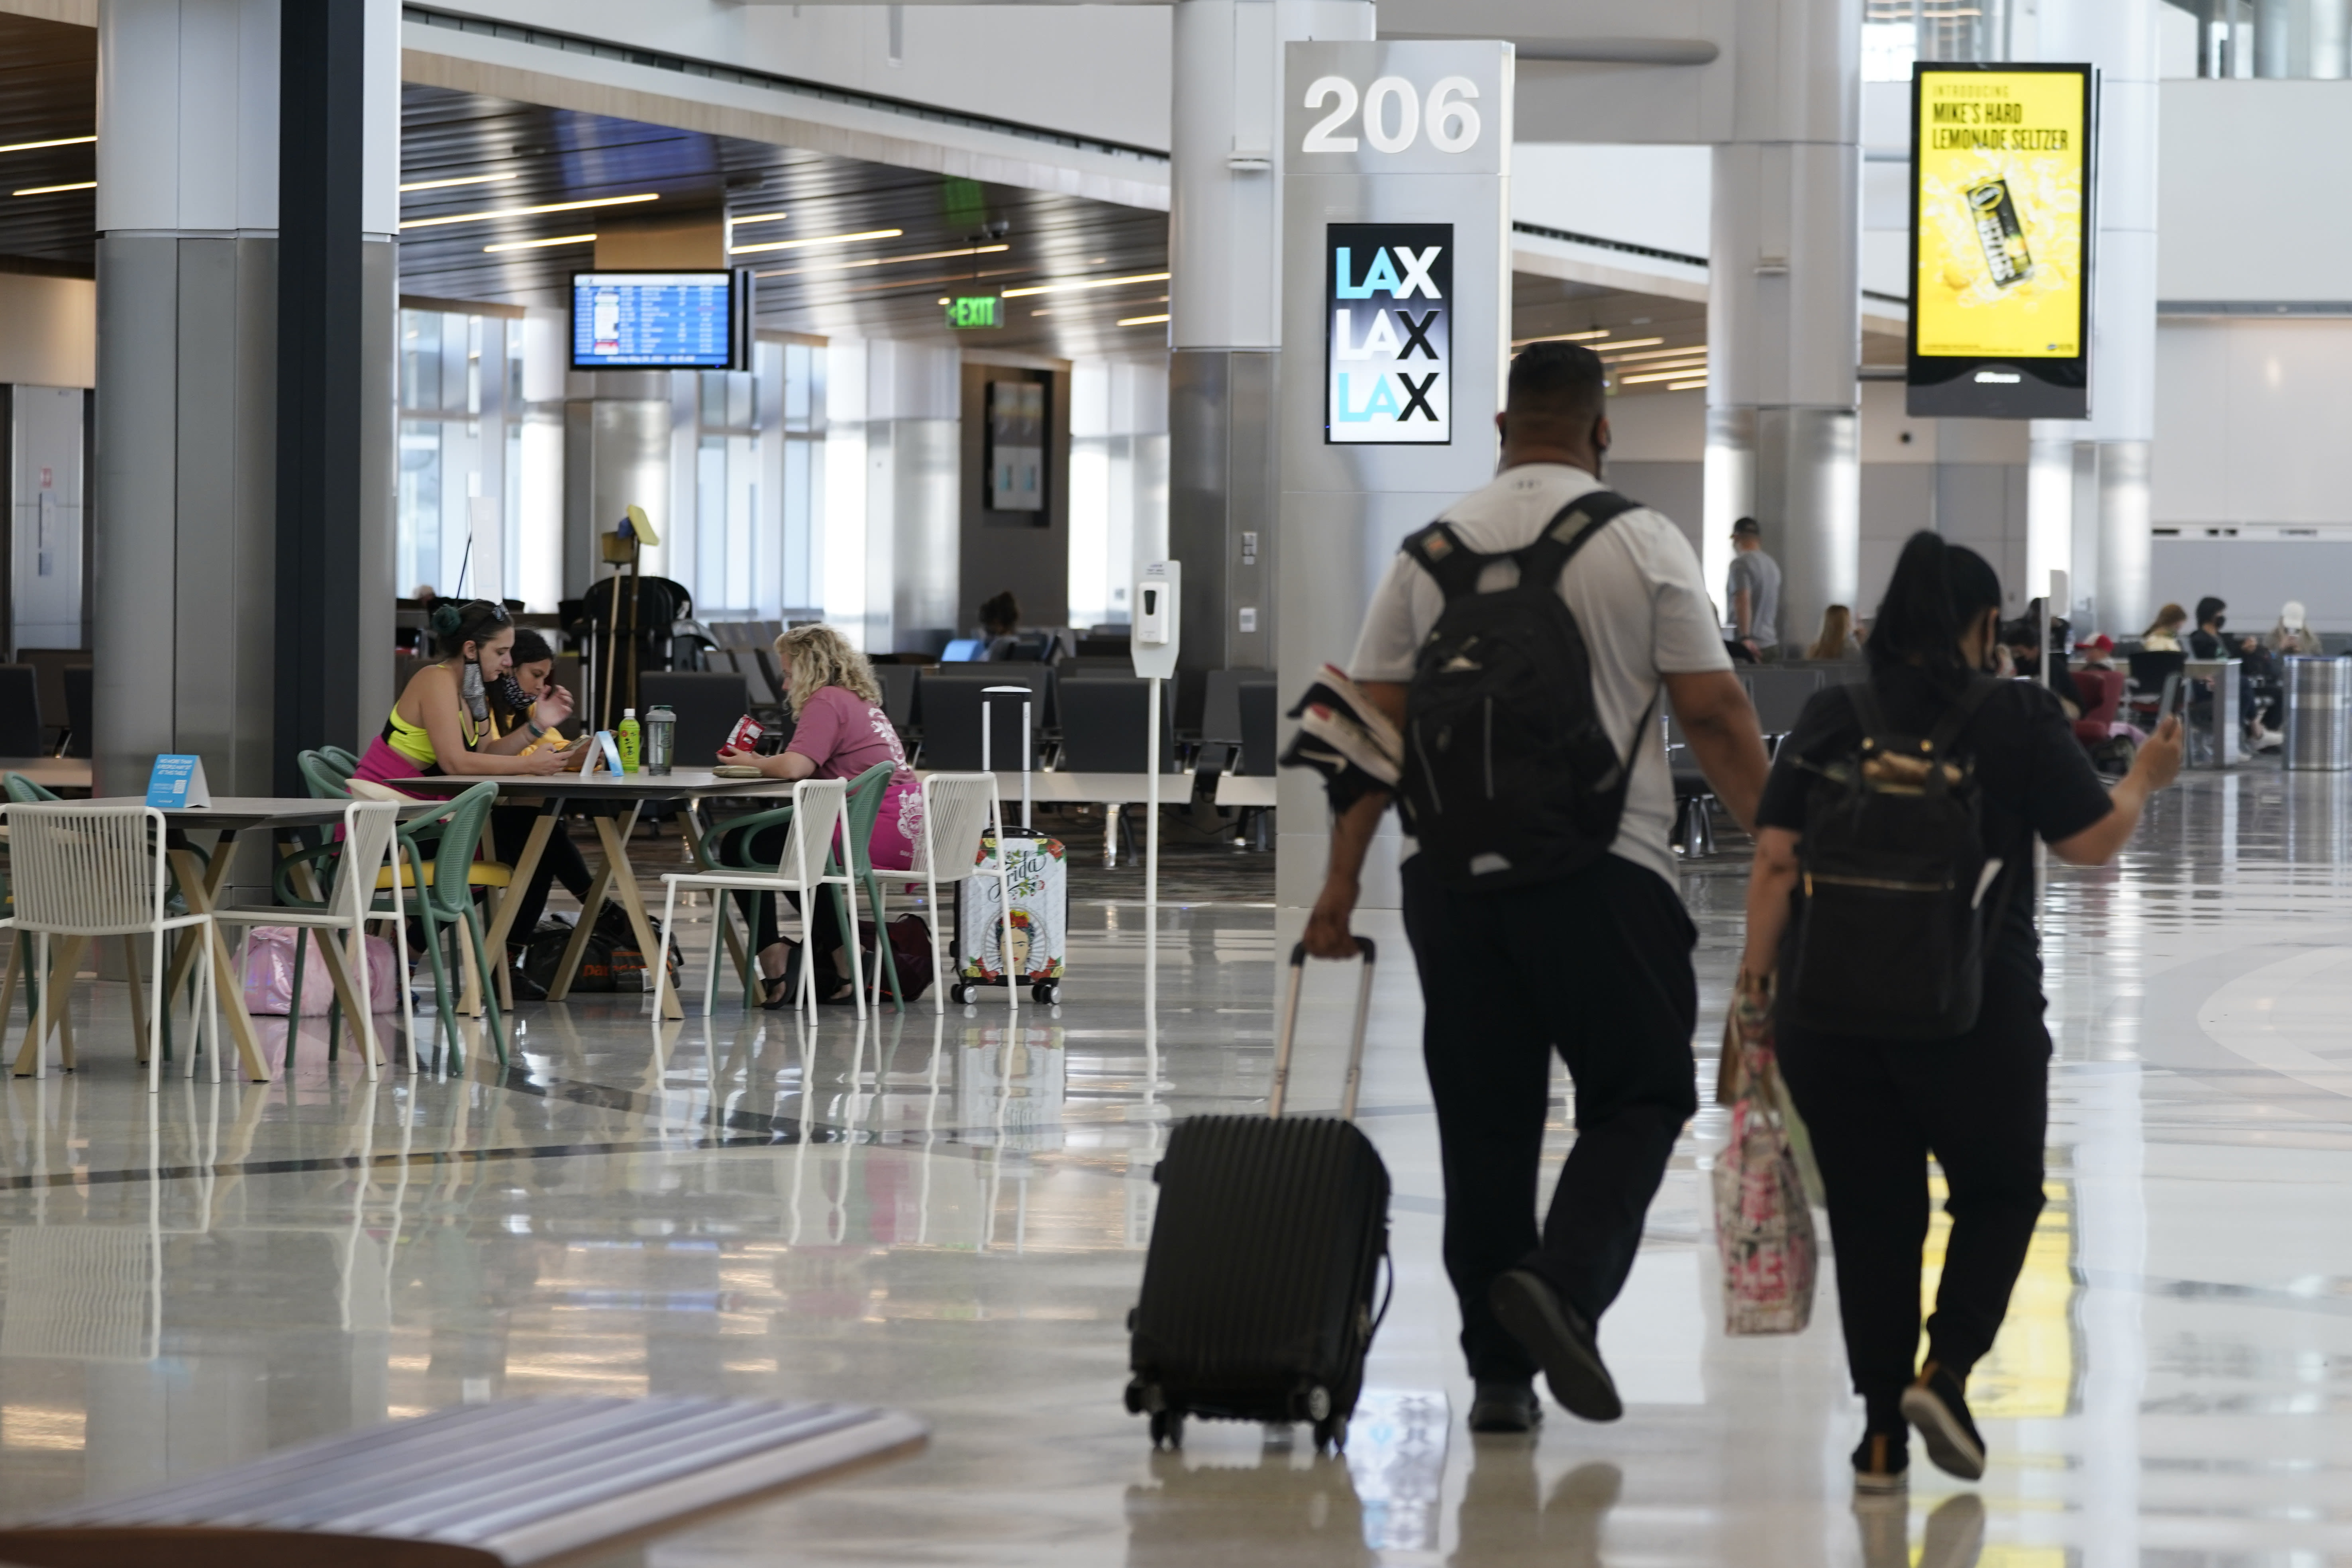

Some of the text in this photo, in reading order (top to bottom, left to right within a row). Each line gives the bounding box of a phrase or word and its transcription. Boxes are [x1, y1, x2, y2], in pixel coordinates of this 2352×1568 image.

[1933, 84, 2009, 98] INTRODUCING
[1302, 76, 1481, 154] 206
[1933, 102, 2022, 124] MIKE'S HARD
[1932, 129, 2069, 151] LEMONADE SELTZER
[1336, 246, 1443, 299] LAX
[956, 296, 996, 326] EXIT
[1336, 308, 1442, 360] LAX
[1338, 373, 1440, 422] LAX
